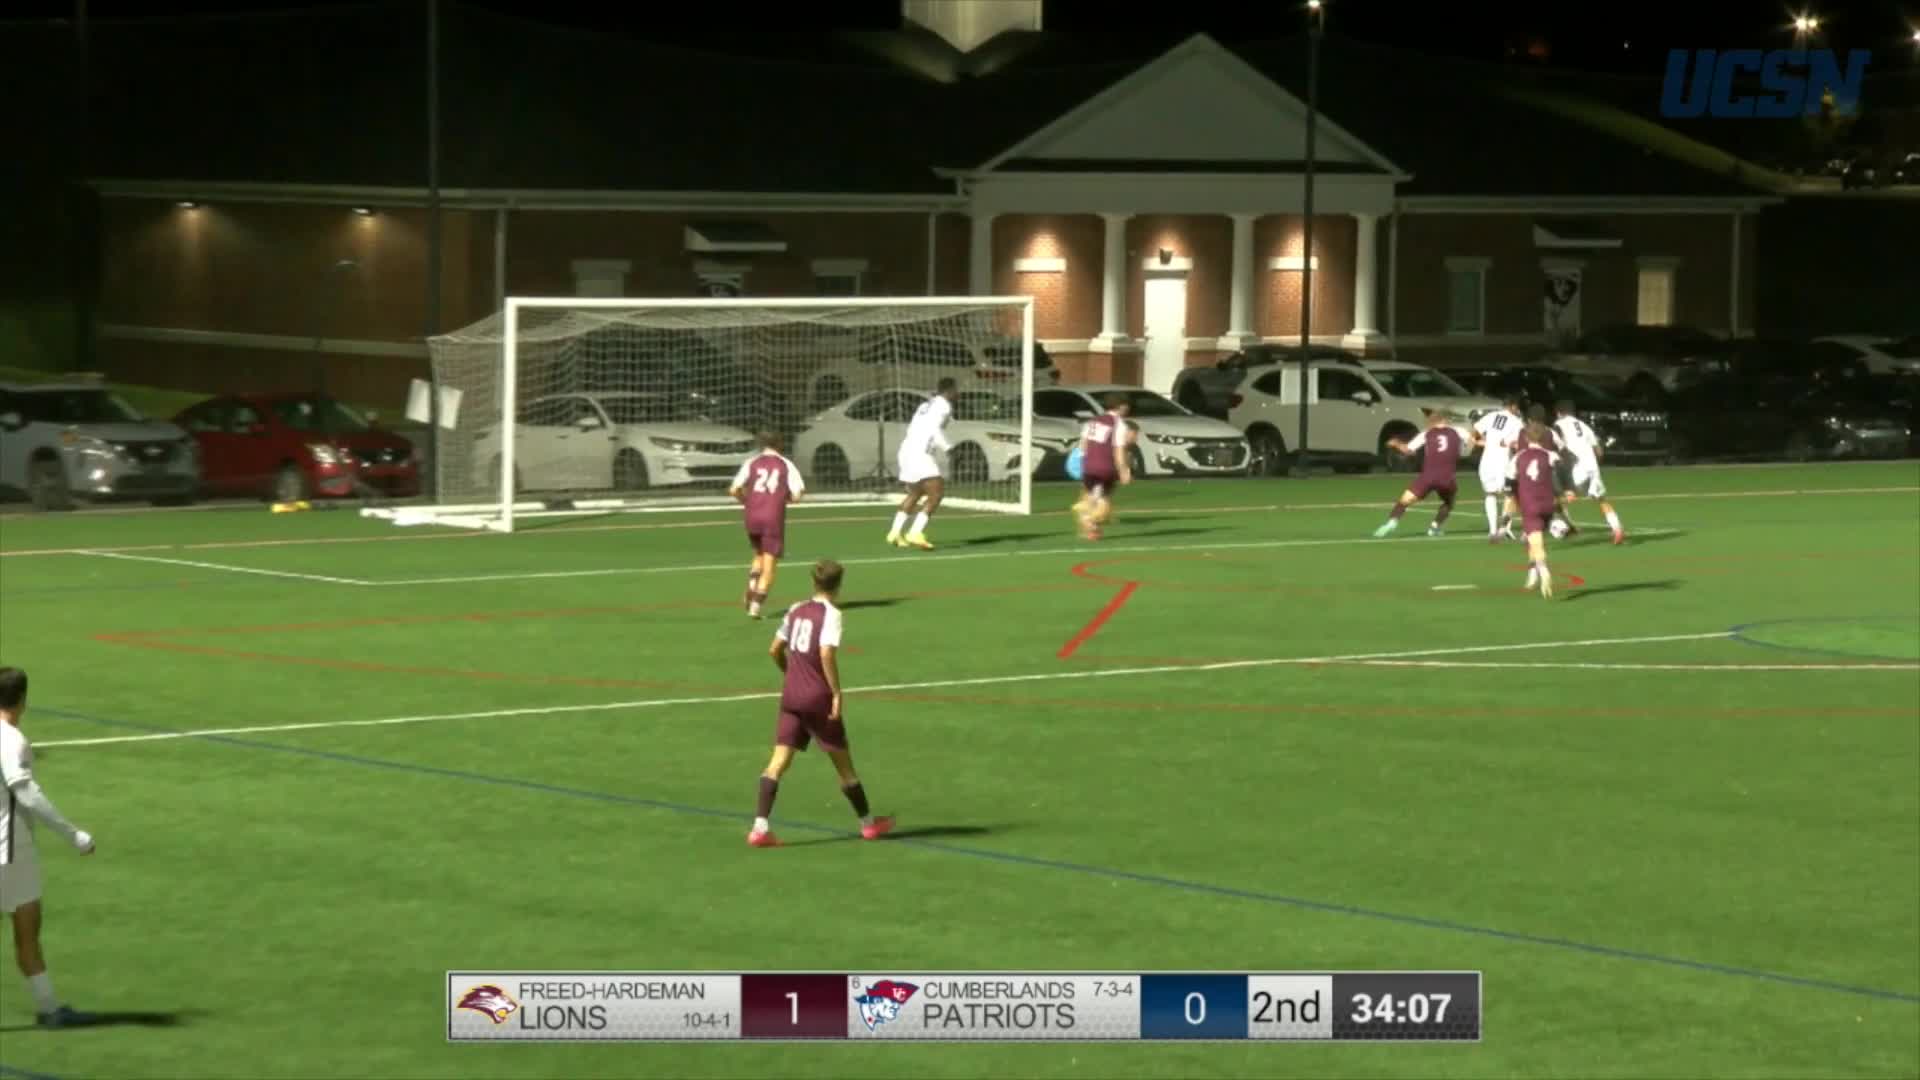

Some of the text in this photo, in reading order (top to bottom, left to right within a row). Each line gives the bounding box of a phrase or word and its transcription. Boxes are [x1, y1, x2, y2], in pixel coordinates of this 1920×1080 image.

[1493, 414, 1508, 430] 10
[1436, 434, 1449, 453] 3
[753, 468, 780, 494] 24
[1525, 459, 1539, 481] 4
[790, 617, 813, 653] 18
